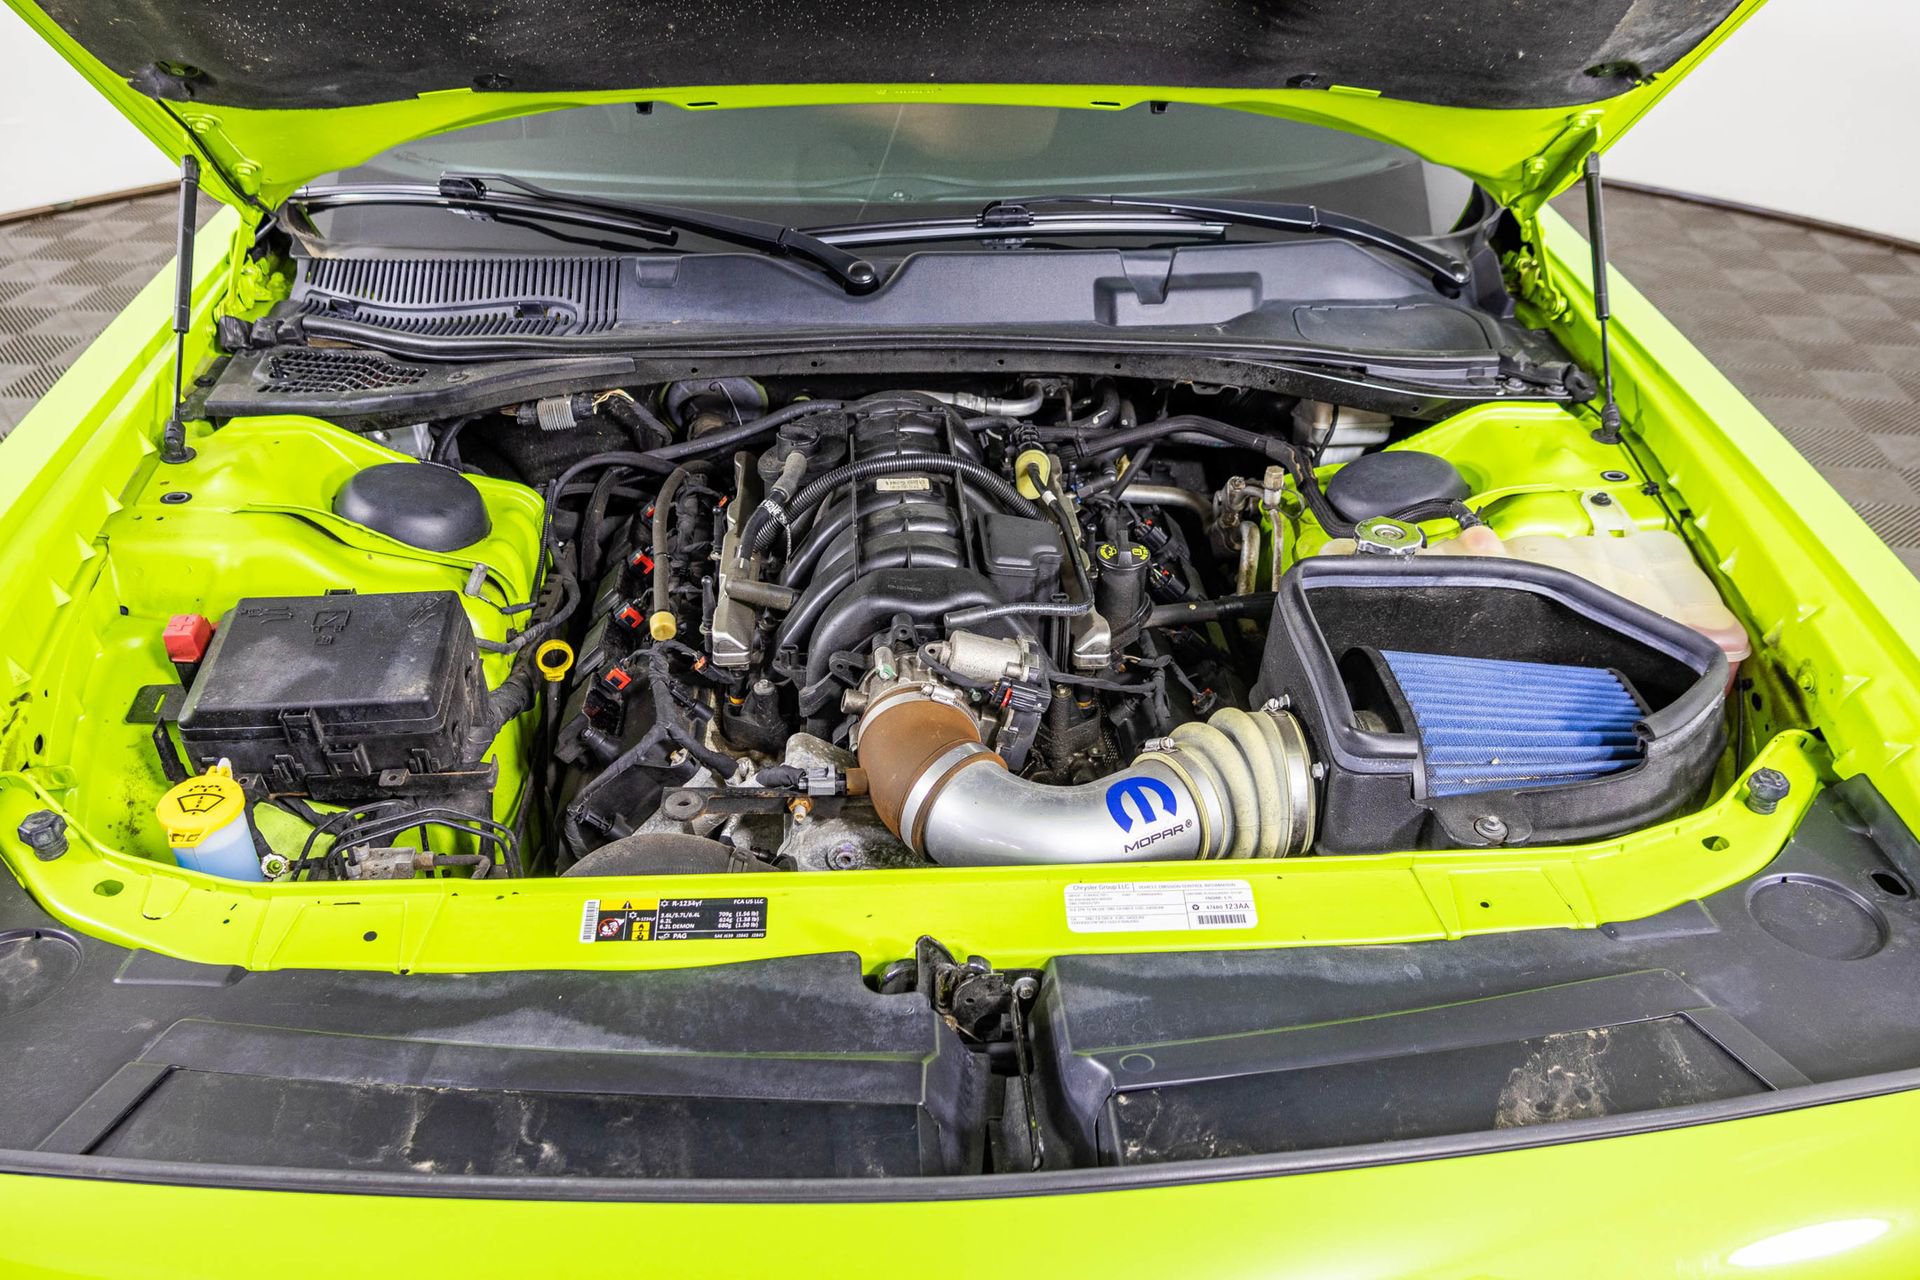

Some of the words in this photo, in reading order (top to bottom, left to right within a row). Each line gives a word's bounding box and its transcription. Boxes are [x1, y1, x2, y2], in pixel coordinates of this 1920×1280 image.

[1073, 884, 1097, 892] Chrysler
[672, 900, 703, 908] R-1234yf
[1225, 902, 1250, 910] 123AA
